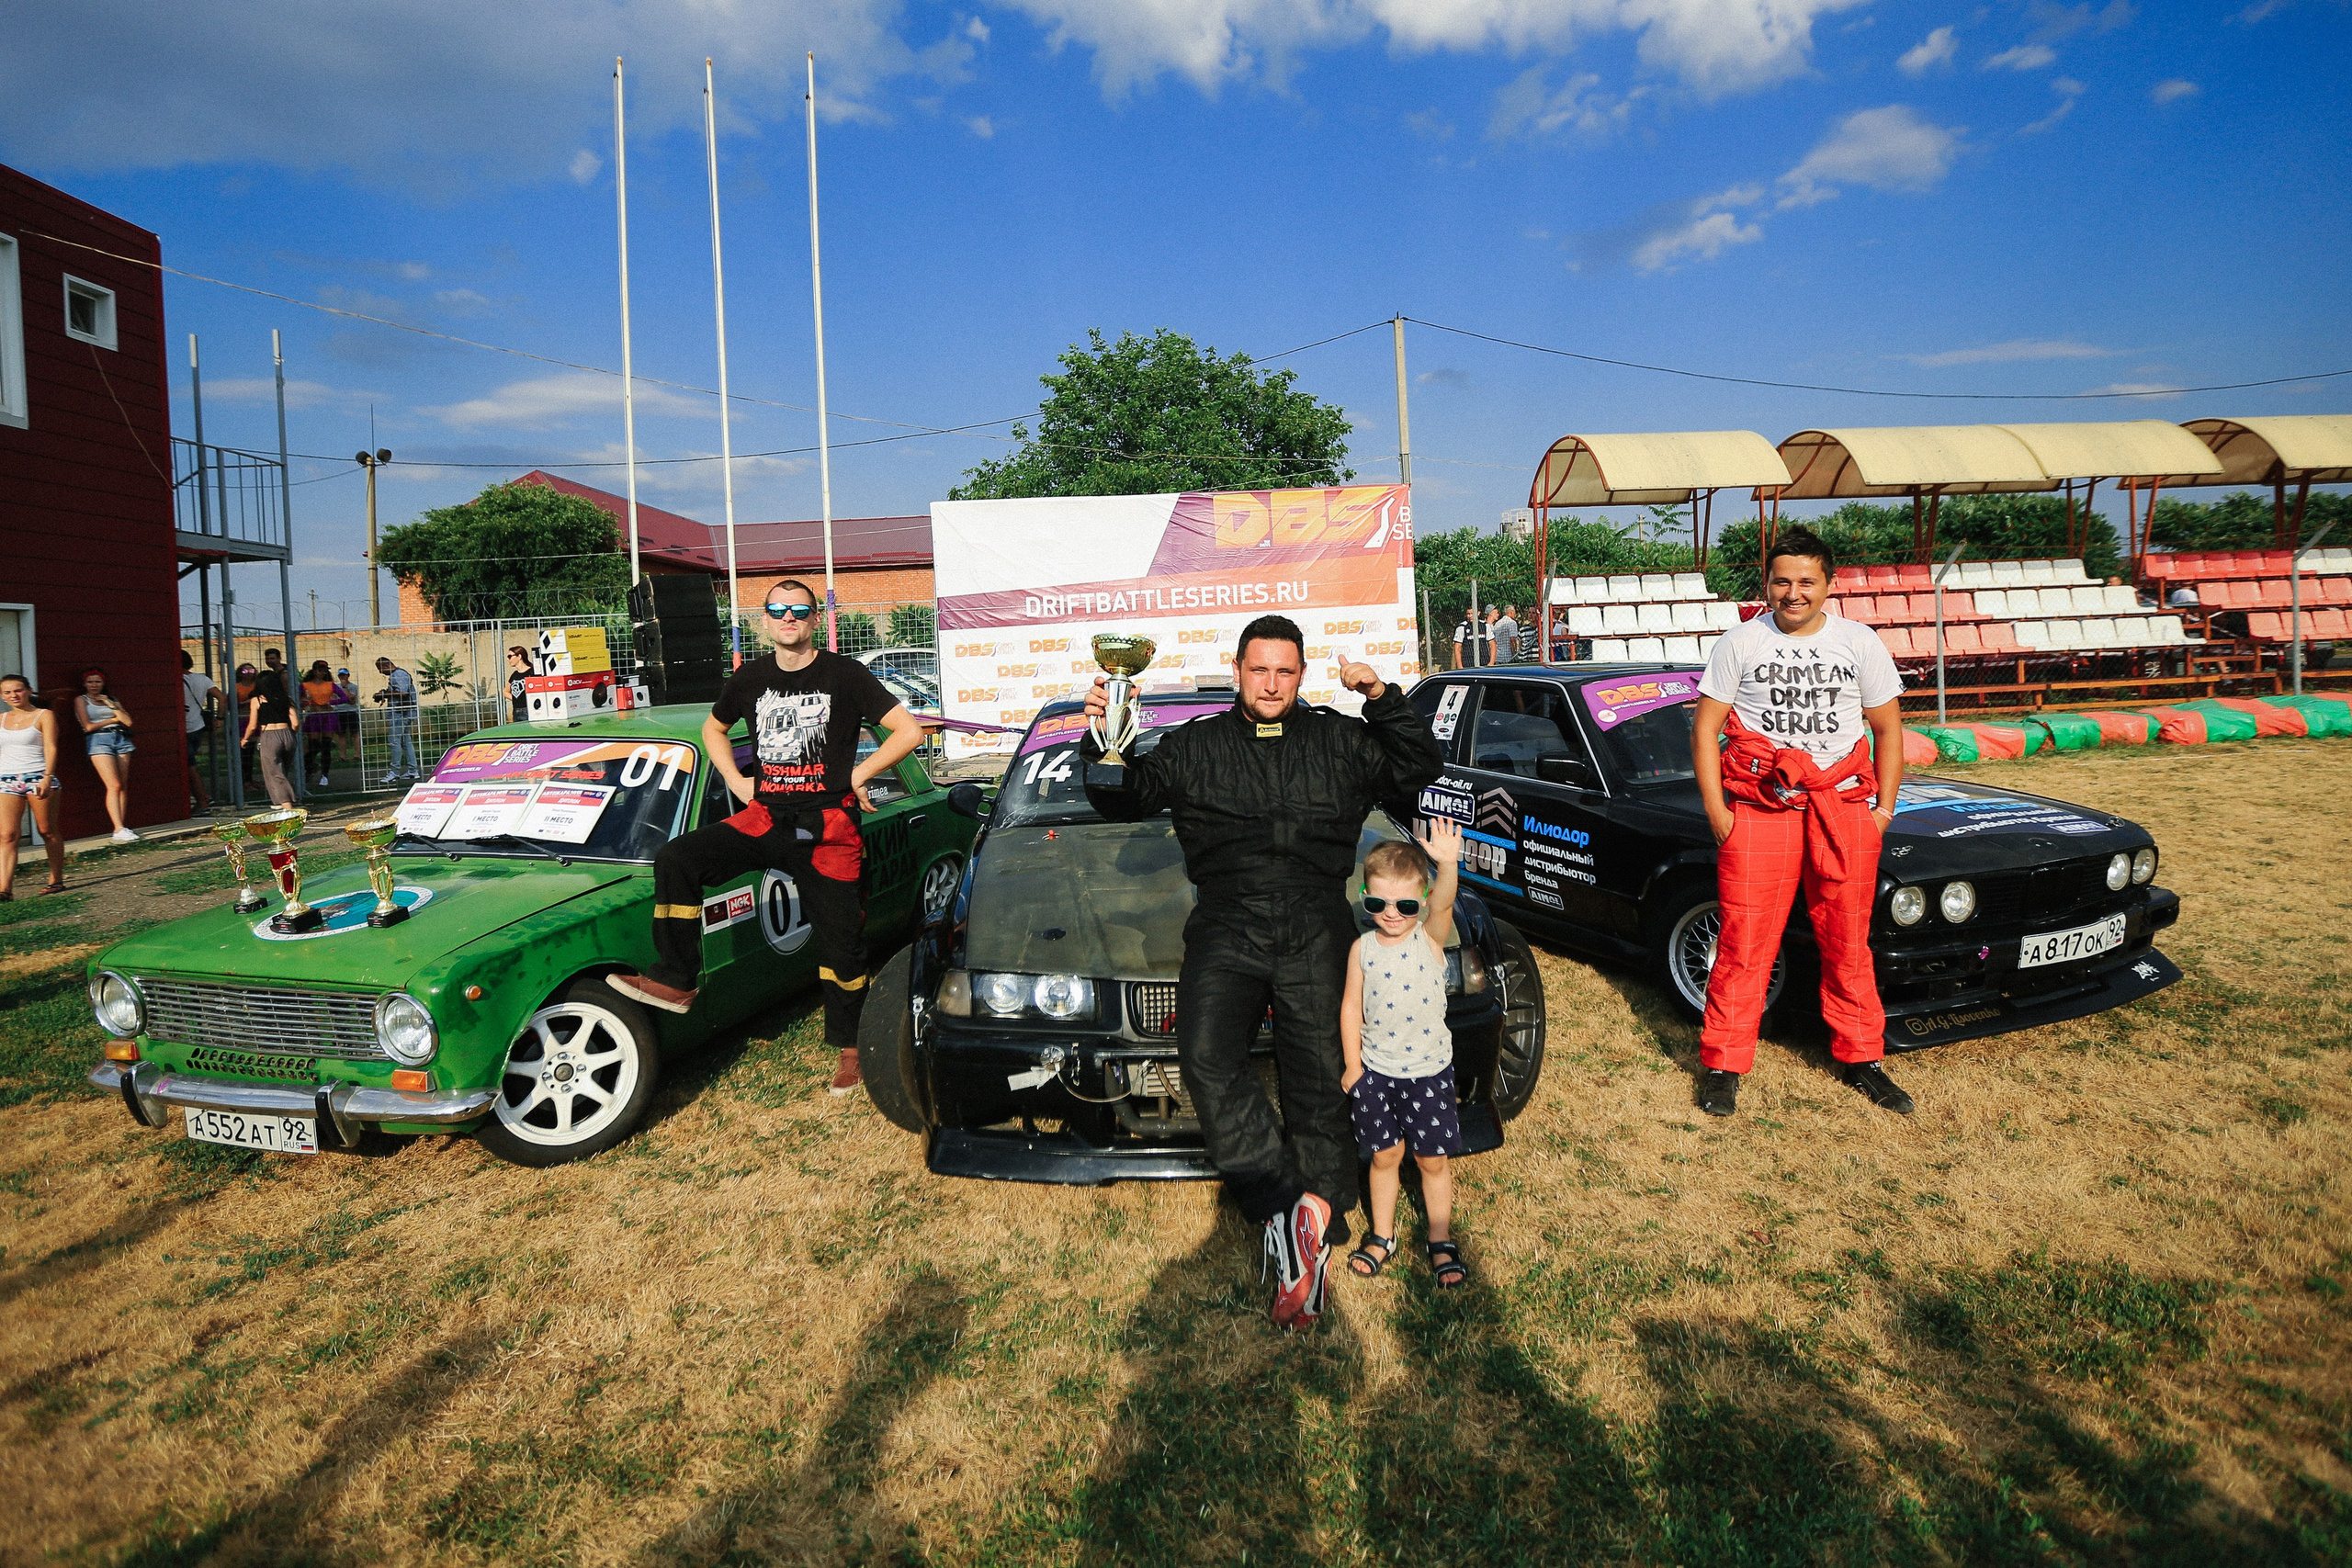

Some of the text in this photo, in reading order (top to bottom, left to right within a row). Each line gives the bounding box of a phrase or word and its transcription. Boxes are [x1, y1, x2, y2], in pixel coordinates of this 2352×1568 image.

[1213, 487, 1390, 549] DBS
[1024, 581, 1308, 617] DRIFTBATTLESERIES.RU
[1306, 645, 1333, 660] BS
[1071, 660, 1103, 674] DB
[1447, 690, 1459, 710] 4
[1596, 682, 1659, 705] DBS
[1770, 686, 1842, 710] DRIFT
[1037, 714, 1089, 736] DB
[1761, 710, 1840, 736] SERIES
[447, 742, 515, 767] DBS
[619, 744, 688, 792] 01
[1023, 750, 1074, 785] 14
[783, 775, 806, 784] YOUR
[1435, 774, 1474, 791] dor-oil.ru
[866, 785, 888, 800] rimea
[1420, 790, 1472, 818] AIMOL
[1523, 815, 1590, 848] Илиодор
[1522, 840, 1594, 866] официальный
[1524, 856, 1597, 886] дистрибьютор
[1524, 869, 1559, 889] бренда
[730, 894, 751, 912] NGK
[769, 879, 810, 937] 0
[1531, 889, 1562, 907] AIMOL
[2109, 919, 2121, 939] 92
[283, 1117, 307, 1141] 92
[283, 1141, 300, 1150] RUS
